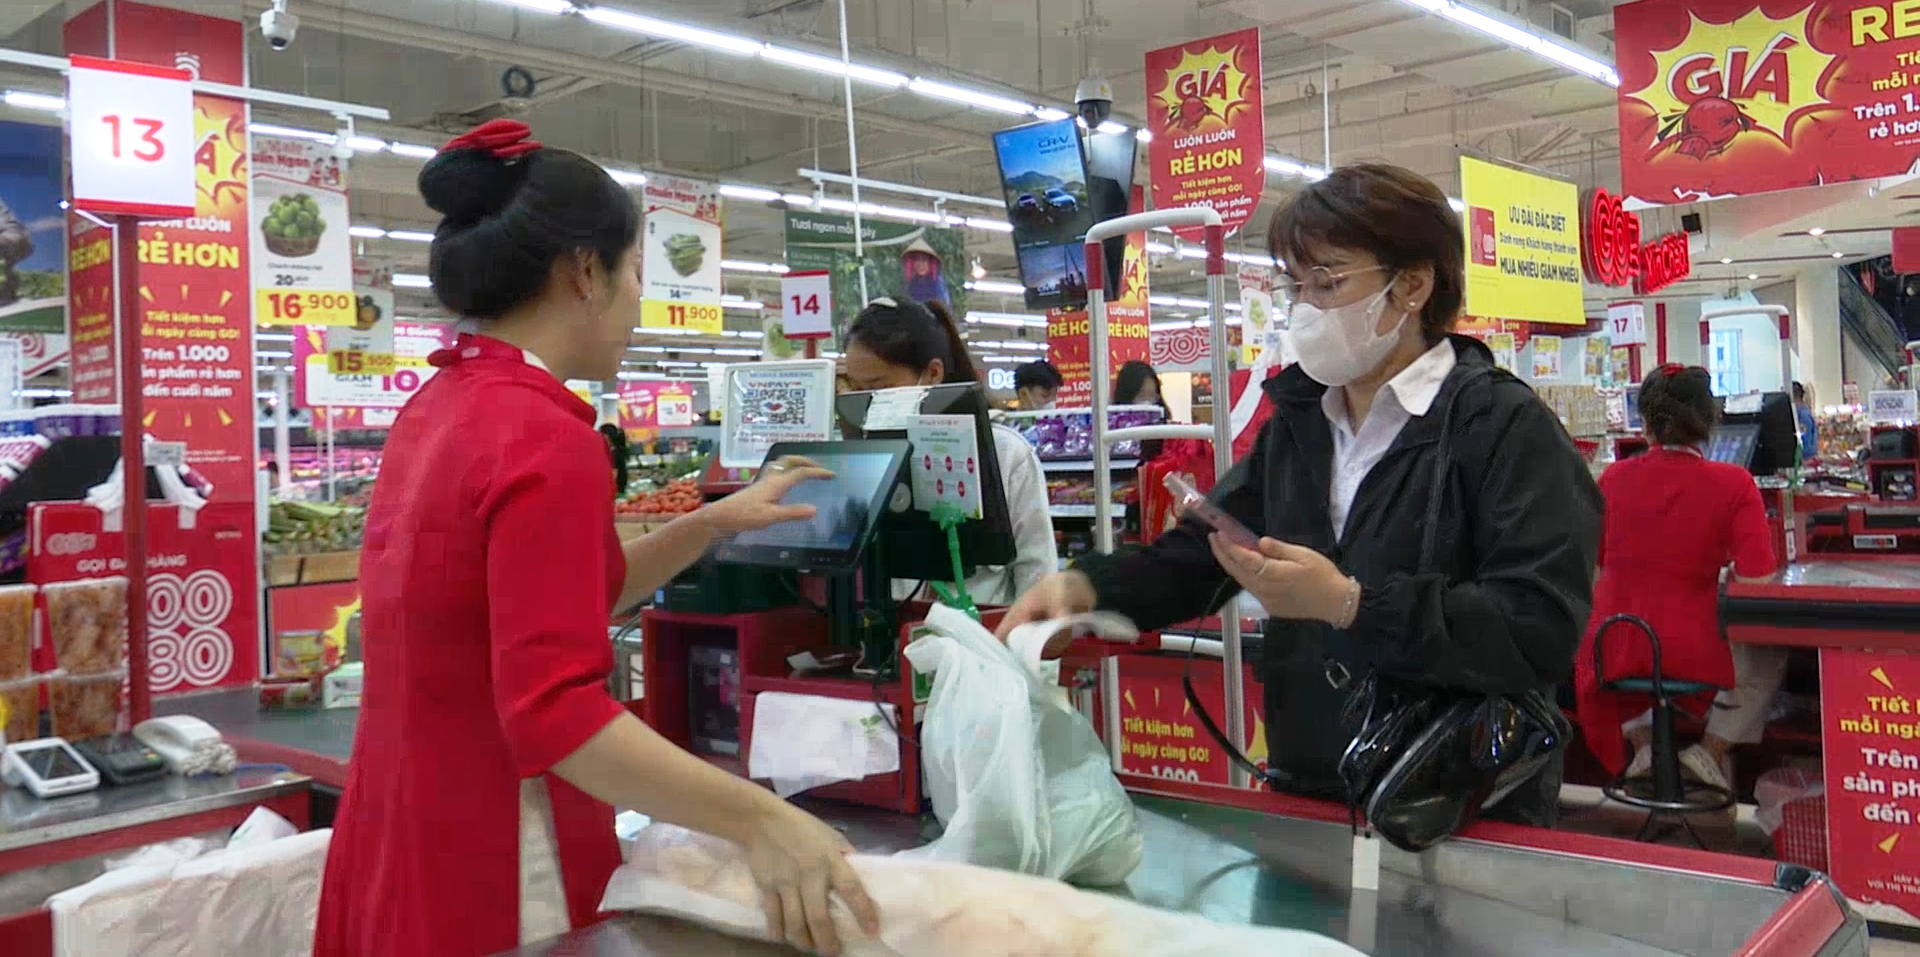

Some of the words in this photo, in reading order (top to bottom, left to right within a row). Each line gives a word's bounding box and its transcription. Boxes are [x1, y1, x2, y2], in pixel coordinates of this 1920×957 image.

[1667, 31, 1800, 106] GIÁ
[1174, 60, 1231, 102] GIÁ
[1872, 70, 1908, 92] mỗi
[1853, 102, 1897, 121] Trên
[102, 114, 165, 162] 13
[1173, 134, 1204, 150] LUÔN
[1205, 128, 1236, 144] LUÔN
[1869, 121, 1889, 139] rẻ
[1169, 150, 1197, 177] RẺ
[1198, 147, 1243, 173] HƠN
[859, 229, 876, 239] gày
[173, 242, 240, 269] HƠN
[791, 293, 820, 316] 14
[1123, 322, 1148, 339] HƠN
[1613, 317, 1628, 334] 17
[176, 344, 230, 362] 1.000
[1867, 695, 1910, 715] Tiết
[1840, 714, 1880, 734] mỗi
[1188, 748, 1210, 763] GO!
[1861, 747, 1919, 770] Trên
[1843, 771, 1886, 794] sản
[1863, 802, 1911, 825] đến
